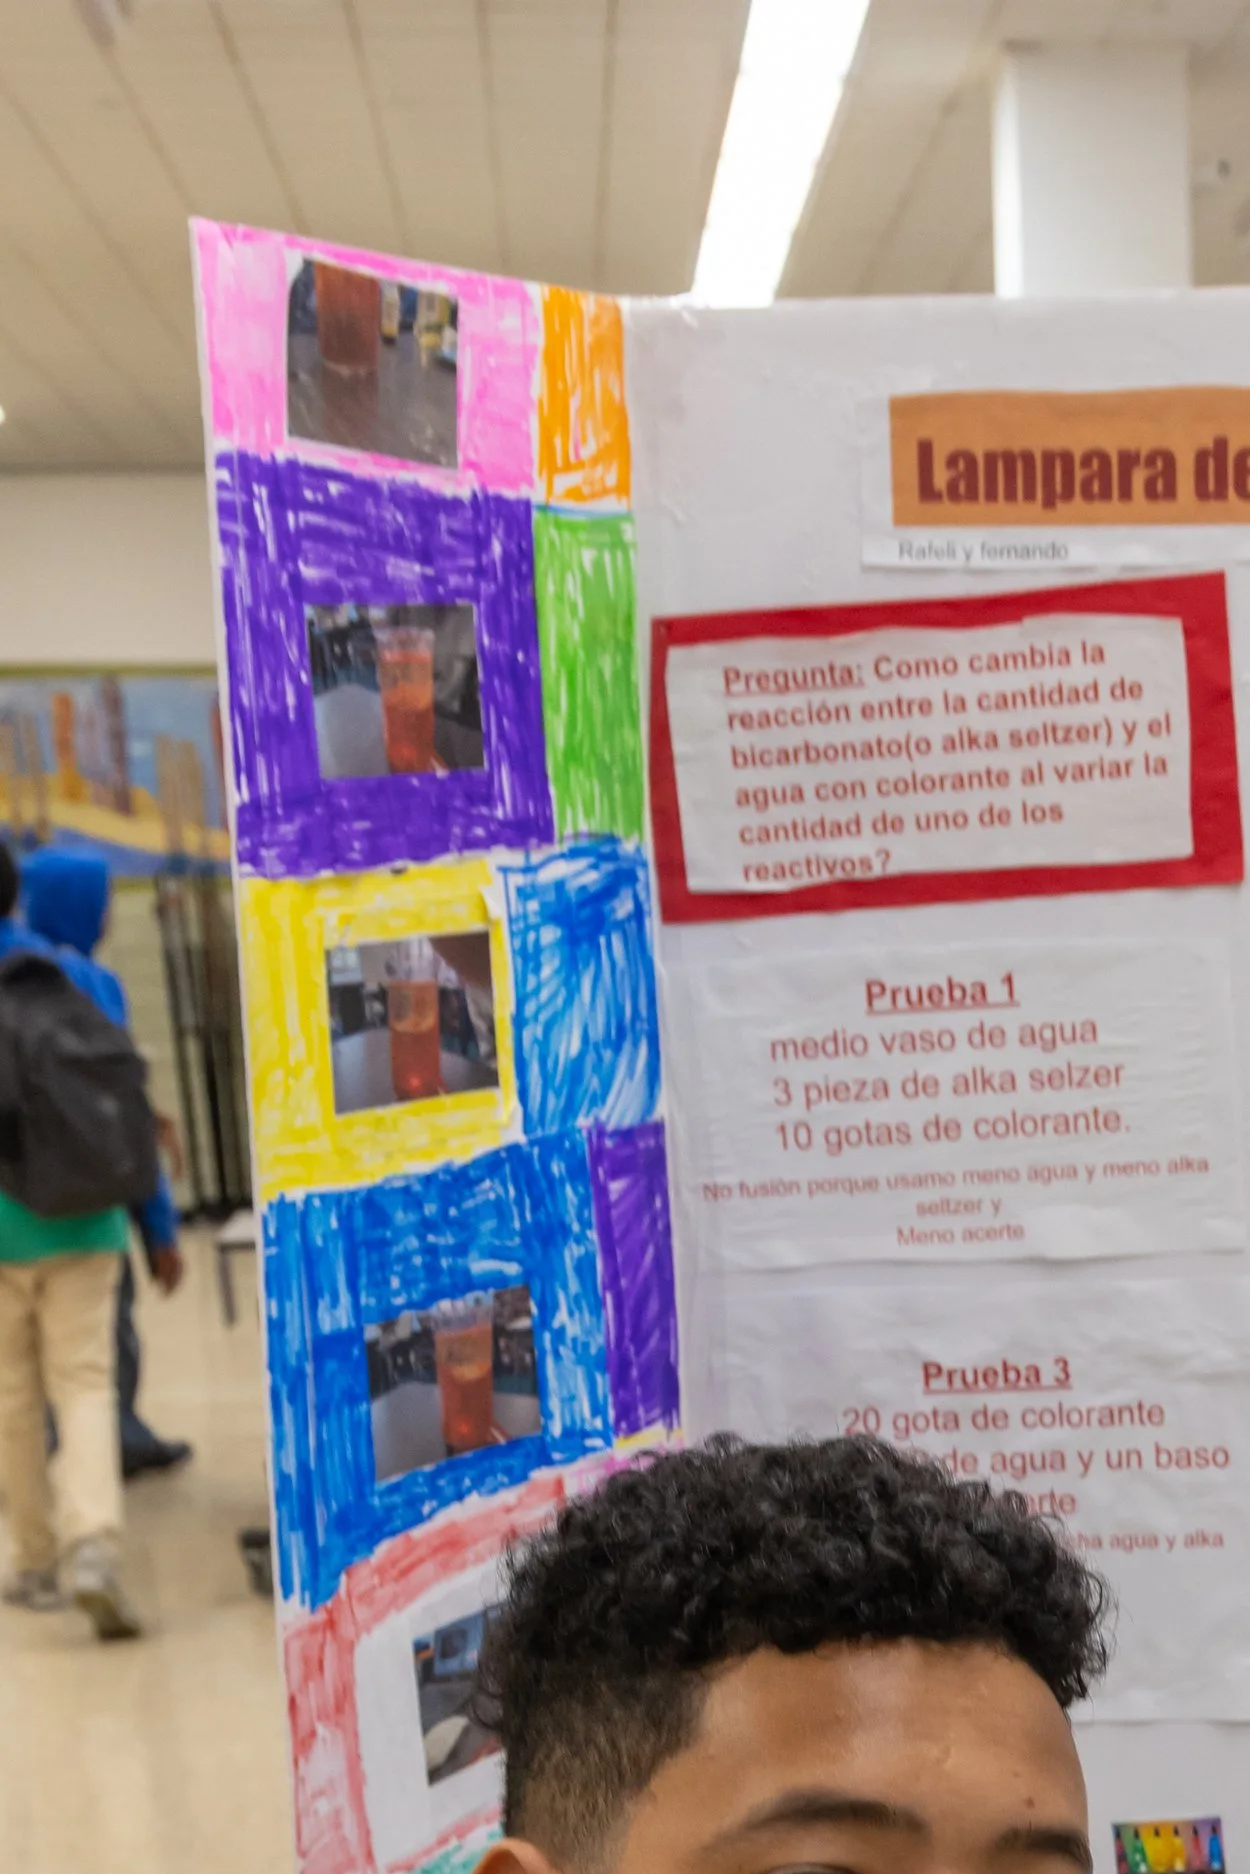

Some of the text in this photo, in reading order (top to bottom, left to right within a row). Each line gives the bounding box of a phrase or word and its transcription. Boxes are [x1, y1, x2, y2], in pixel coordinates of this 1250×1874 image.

[916, 437, 1177, 511] Lampara
[961, 543, 973, 565] y
[722, 639, 1105, 697] Pregunta: Como cambia la
[726, 676, 1143, 732] reacción entre la cantidad de
[941, 726, 999, 754] alka
[1121, 719, 1137, 747] y
[1147, 709, 1171, 738] el
[735, 752, 1168, 813] agua con colorante al variar la
[738, 801, 1064, 845] cantidad de uno de los
[741, 847, 892, 882] reactivos?
[864, 971, 1015, 1015] Prueba 1
[769, 1018, 1098, 1063] medio vaso de agua
[772, 1060, 1123, 1109] 3 pieza de alka selzer
[776, 1105, 1133, 1156] 10 gotas de colorante.
[920, 1356, 1071, 1395] Prueba 3
[842, 1398, 1164, 1437] 20 gota de colorante
[989, 1448, 1066, 1477] agua
[1076, 1449, 1094, 1476] y
[1105, 1447, 1143, 1471] un
[1153, 1441, 1230, 1470] baso
